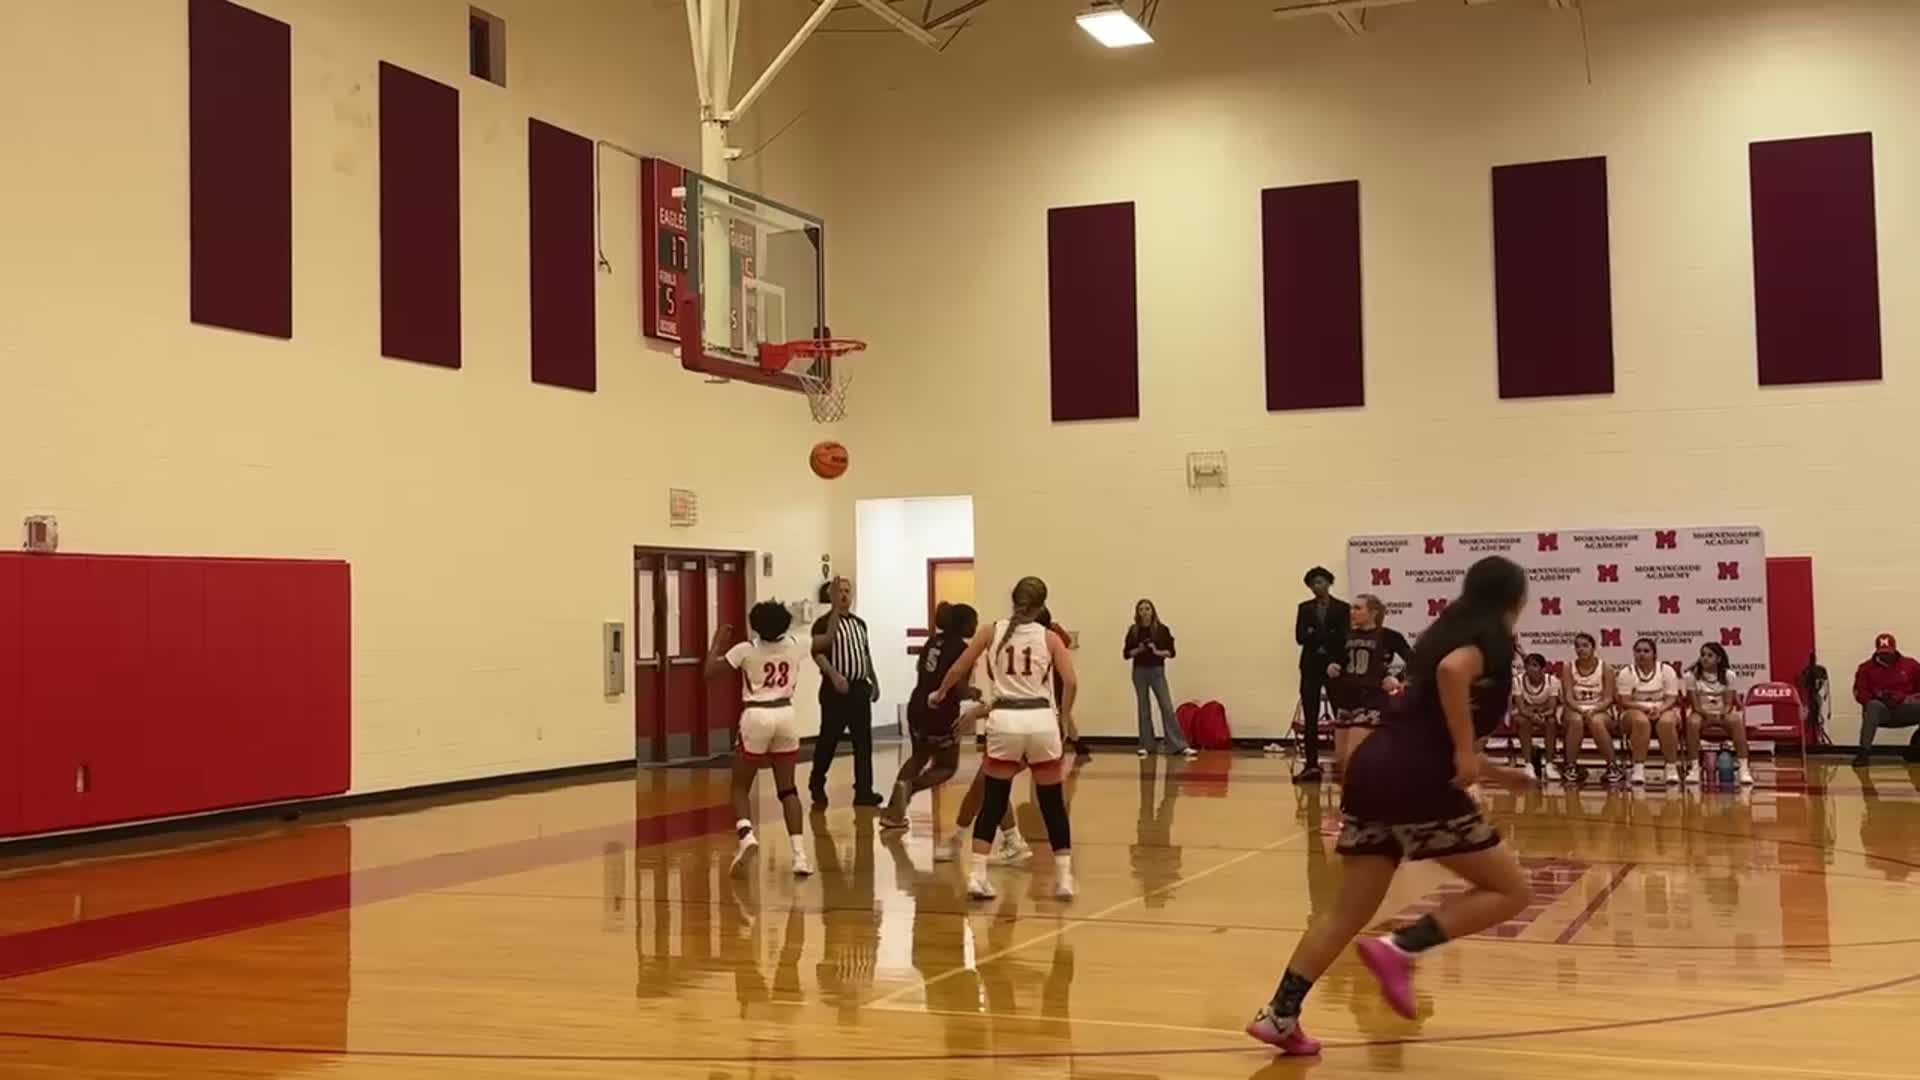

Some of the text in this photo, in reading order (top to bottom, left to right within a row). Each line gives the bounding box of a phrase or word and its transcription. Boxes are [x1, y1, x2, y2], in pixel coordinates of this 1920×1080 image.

[659, 207, 687, 231] EAGLES
[1349, 539, 1409, 547] MORNINGSIDE
[1537, 533, 1559, 552] M
[1573, 534, 1639, 542] MORNINGSIDE
[1655, 530, 1677, 549] M
[1692, 531, 1761, 540] MORNINGSIDE
[1424, 536, 1445, 554] M
[1371, 568, 1391, 586] M
[1405, 569, 1465, 577] MORNINGSIDE
[1597, 564, 1619, 583] M
[1634, 565, 1701, 573] MORNINGSIDE
[1717, 561, 1739, 580] M
[1540, 597, 1562, 615] M
[1576, 599, 1642, 607] MORNINGSIDE
[1658, 595, 1680, 614] M
[1696, 597, 1764, 605] MORNINGSIDE
[1707, 604, 1752, 612] ACADEMY
[1601, 628, 1622, 647] M
[1720, 627, 1742, 646] M
[1004, 646, 1033, 676] 11
[1346, 648, 1369, 675] 10
[763, 661, 790, 688] 23
[1753, 688, 1792, 697] EAGLES
